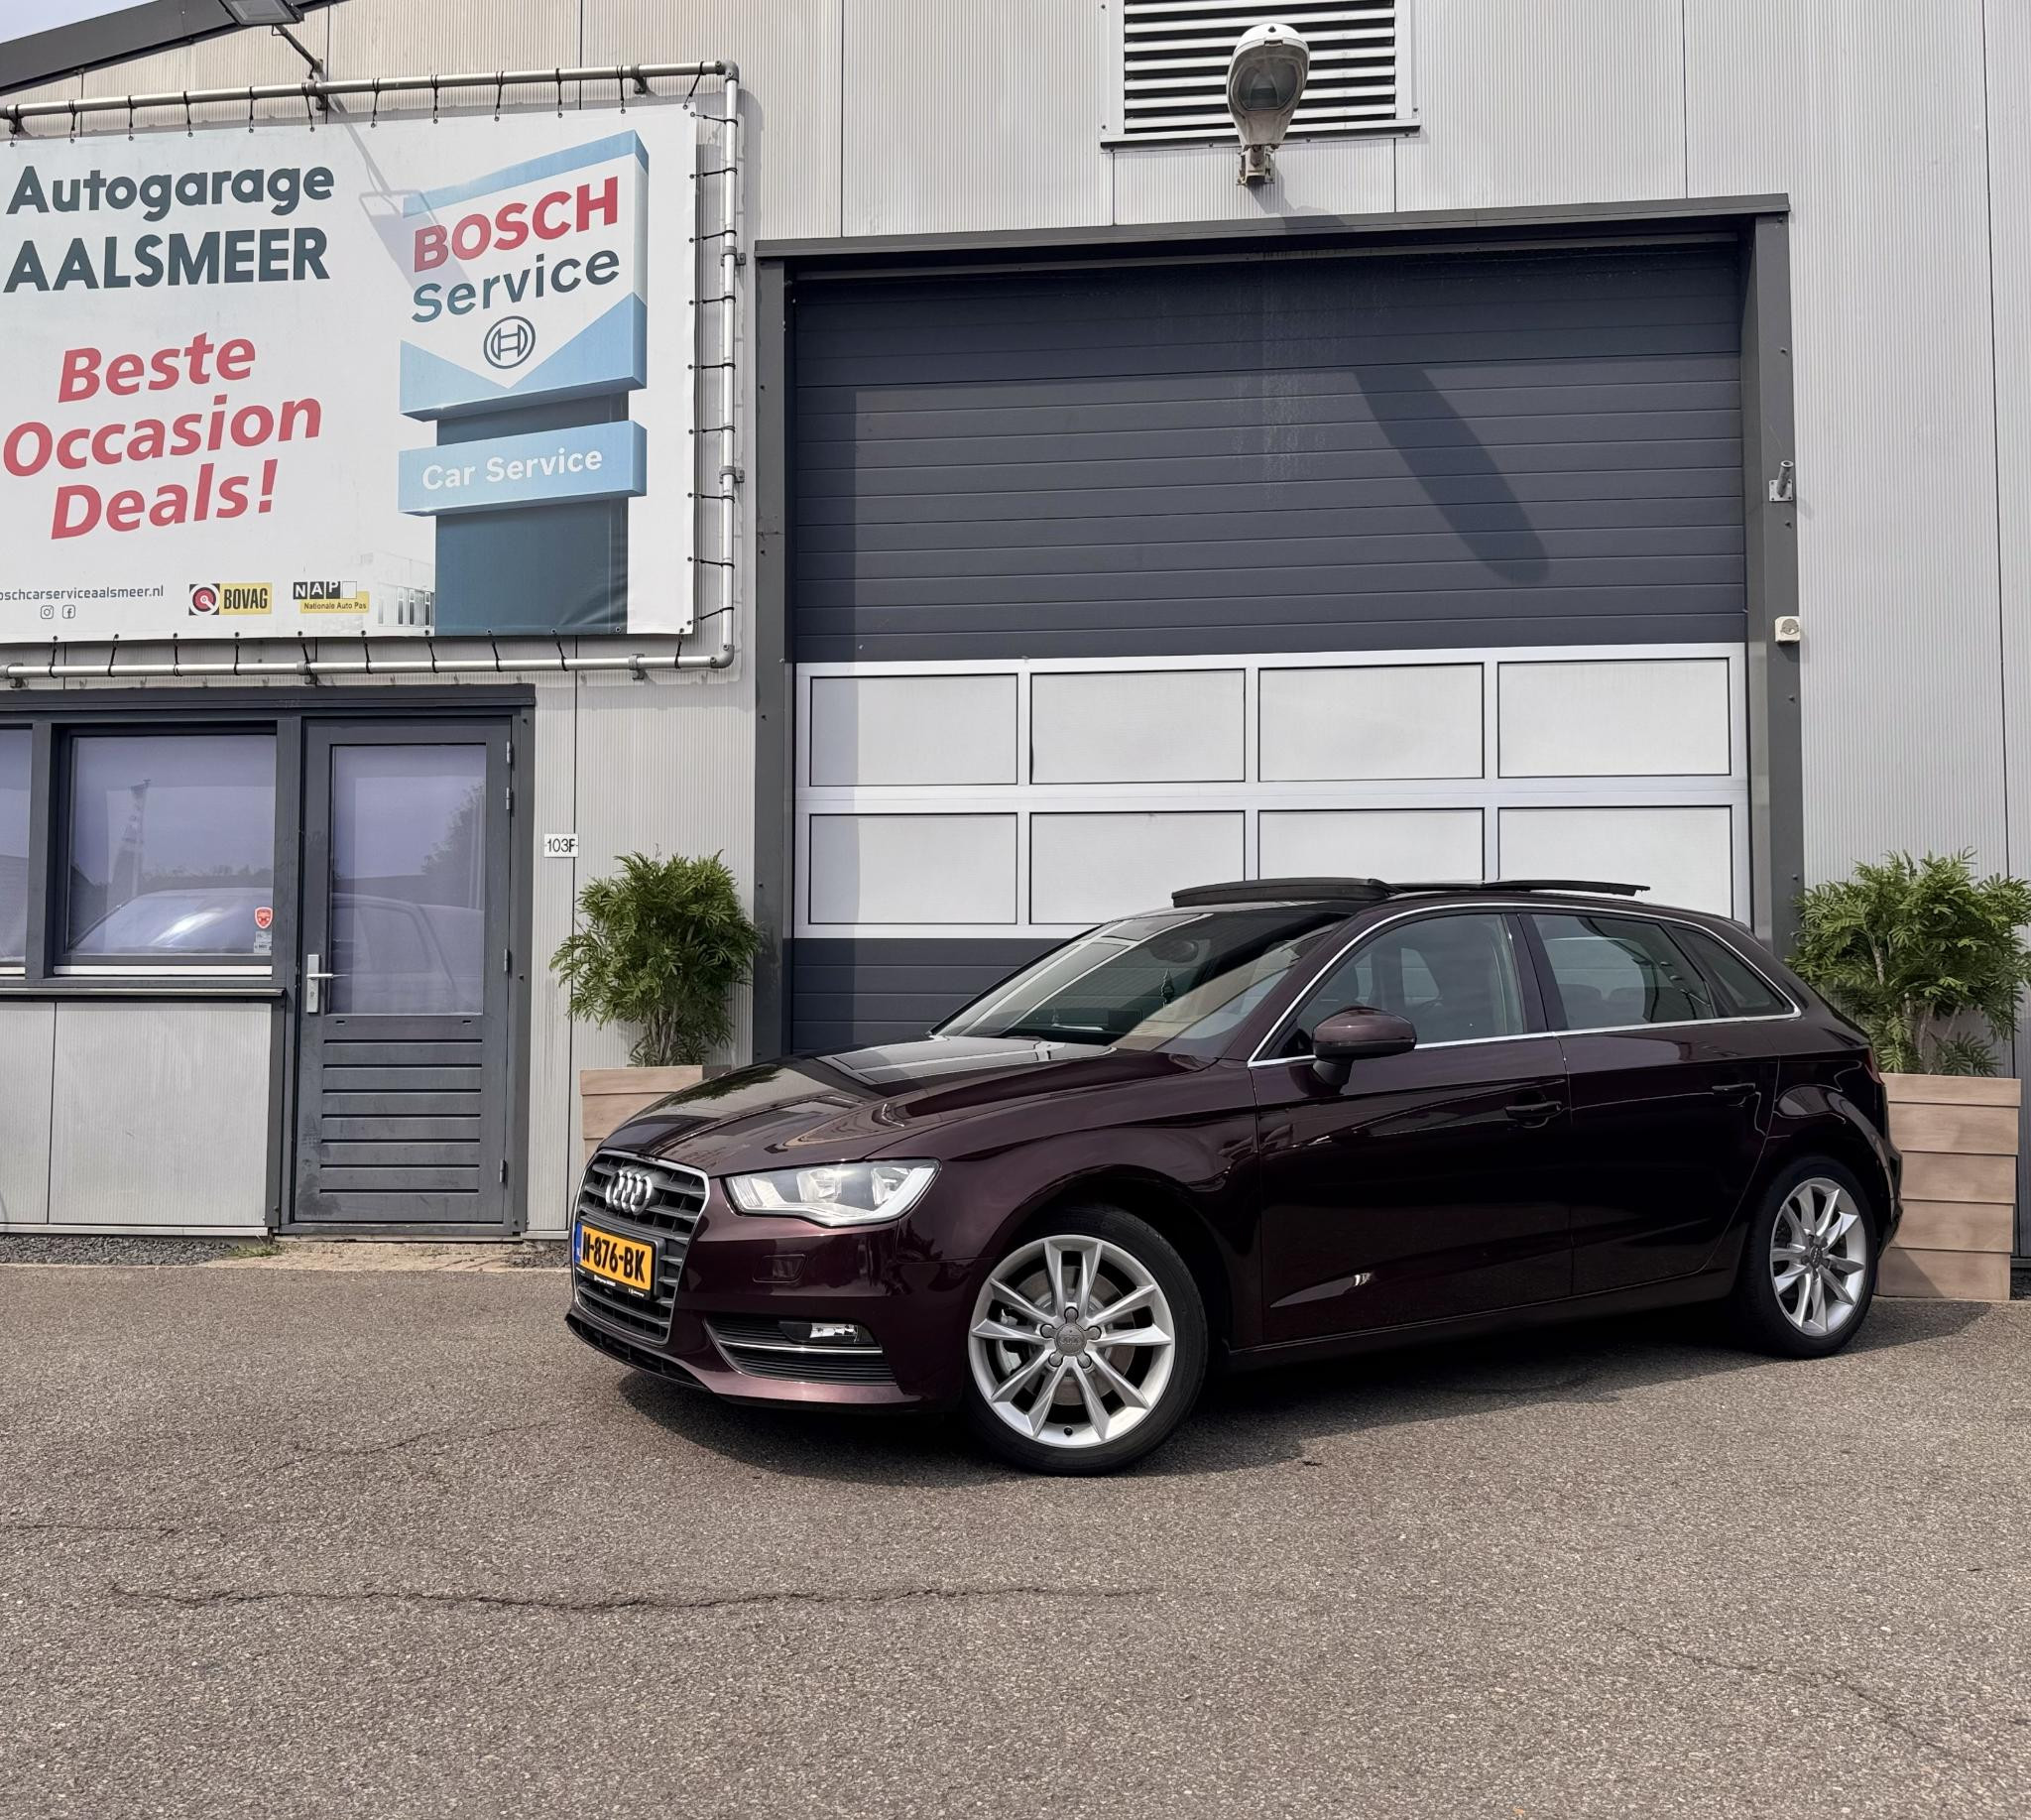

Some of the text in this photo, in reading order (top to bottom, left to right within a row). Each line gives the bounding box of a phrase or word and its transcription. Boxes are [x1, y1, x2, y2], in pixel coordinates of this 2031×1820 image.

[6, 166, 334, 222] Autogarage
[414, 176, 619, 273] BOSCH
[3, 227, 330, 293] AALSMEER
[412, 250, 620, 322] Service
[58, 332, 256, 403] Beste
[3, 394, 321, 477] Occasion
[51, 458, 279, 540] Deals!
[422, 447, 603, 490] Car Service
[223, 588, 268, 609] BOVAG
[295, 581, 339, 598] NAP
[547, 838, 576, 853] 103F
[582, 1231, 646, 1284] N-876-BK
